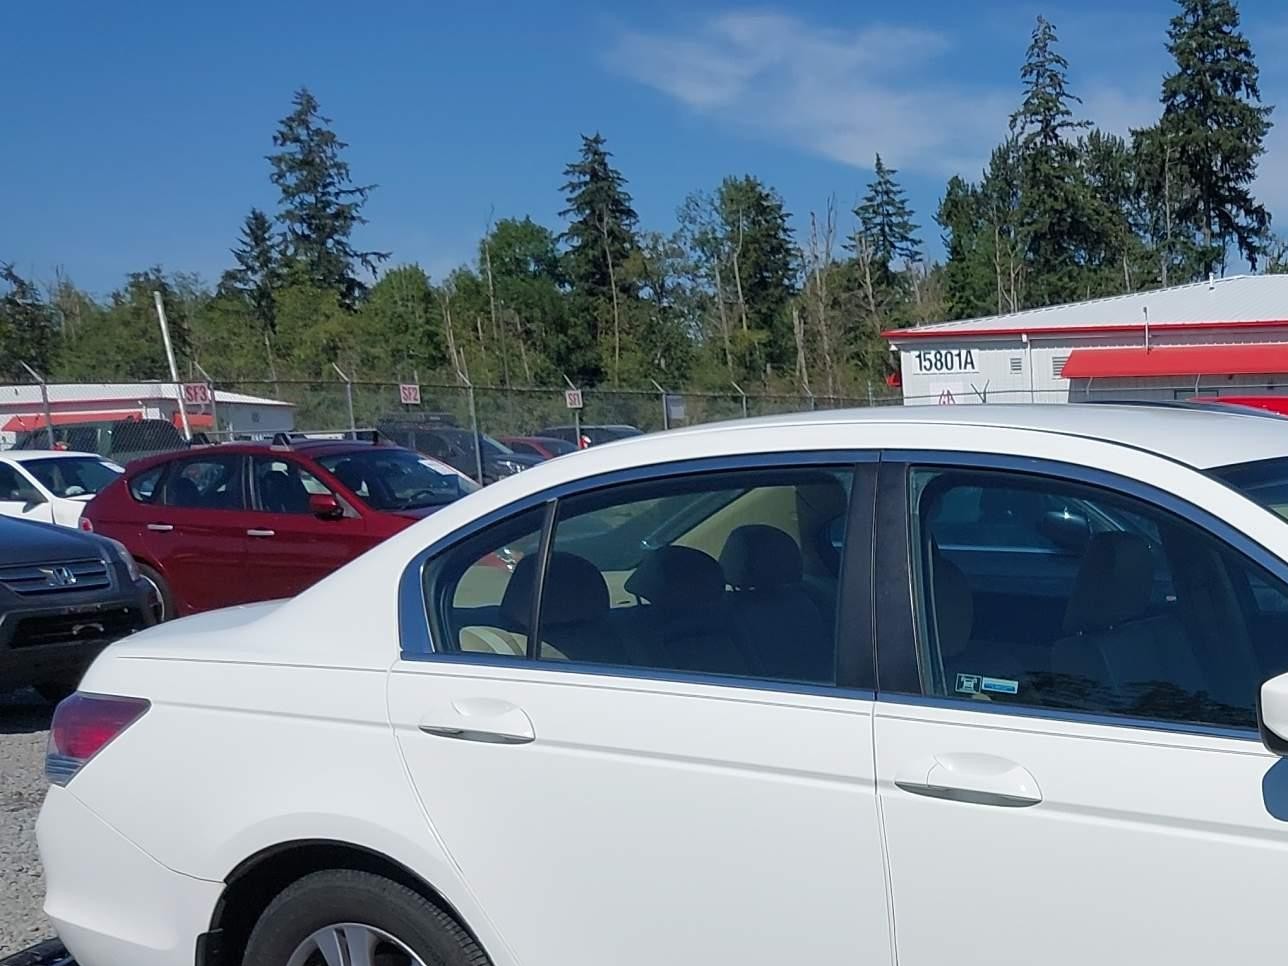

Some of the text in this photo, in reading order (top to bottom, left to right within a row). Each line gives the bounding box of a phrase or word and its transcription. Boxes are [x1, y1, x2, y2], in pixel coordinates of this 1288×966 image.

[915, 349, 975, 372] 15801A
[186, 385, 208, 402] SF3
[402, 387, 419, 402] SF2
[568, 393, 581, 406] SF1
